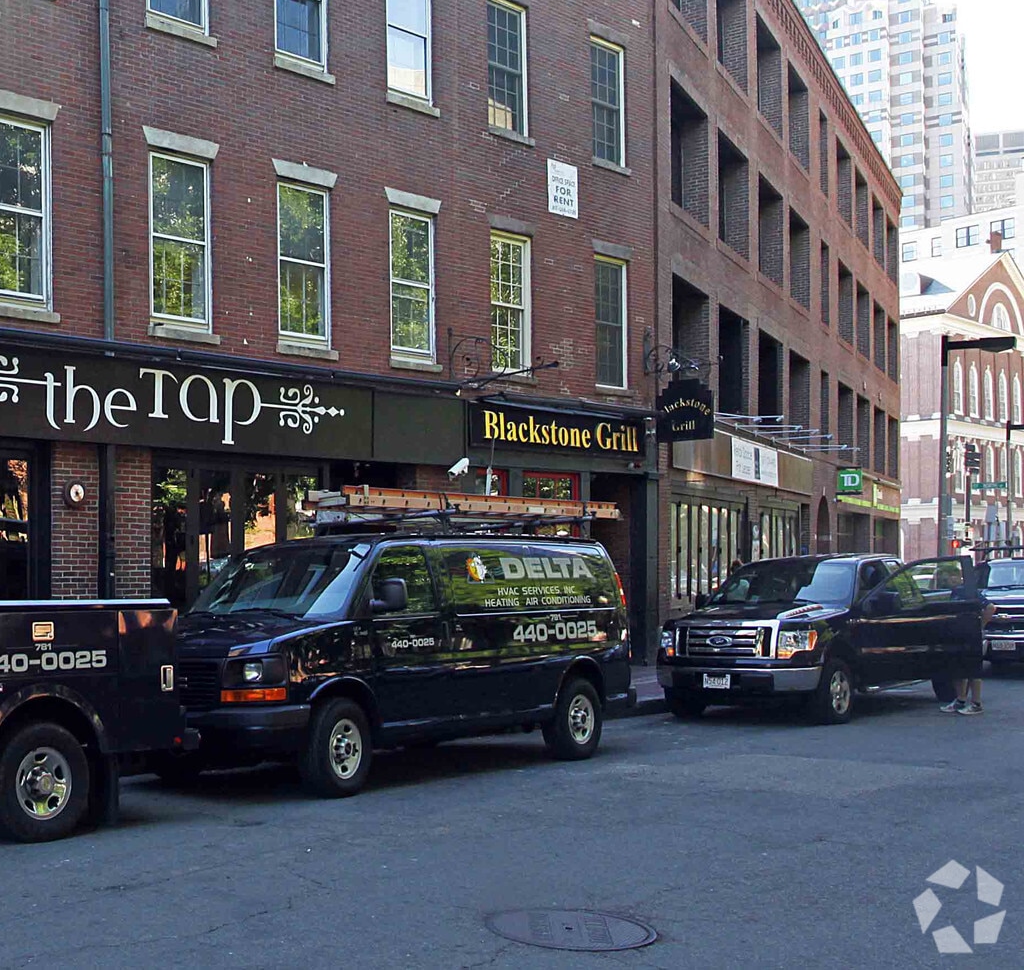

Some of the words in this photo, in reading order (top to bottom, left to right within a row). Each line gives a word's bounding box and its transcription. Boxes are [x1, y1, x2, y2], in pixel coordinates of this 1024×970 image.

[556, 185, 572, 198] FOR
[553, 194, 574, 208] RENT
[45, 365, 137, 431] the
[663, 397, 711, 416] lackstone
[483, 409, 591, 449] Blackstone
[596, 422, 639, 453] Grill
[671, 419, 696, 432] Grill
[840, 473, 860, 487] TD
[499, 557, 593, 579] DELTA
[497, 587, 519, 596] HVAC
[485, 597, 520, 607] HEATING
[526, 597, 538, 605] AIR
[541, 595, 591, 605] CONDITIONING
[513, 620, 597, 643] 440-0025
[35, 643, 52, 651] 781
[391, 637, 434, 648] 440-0025
